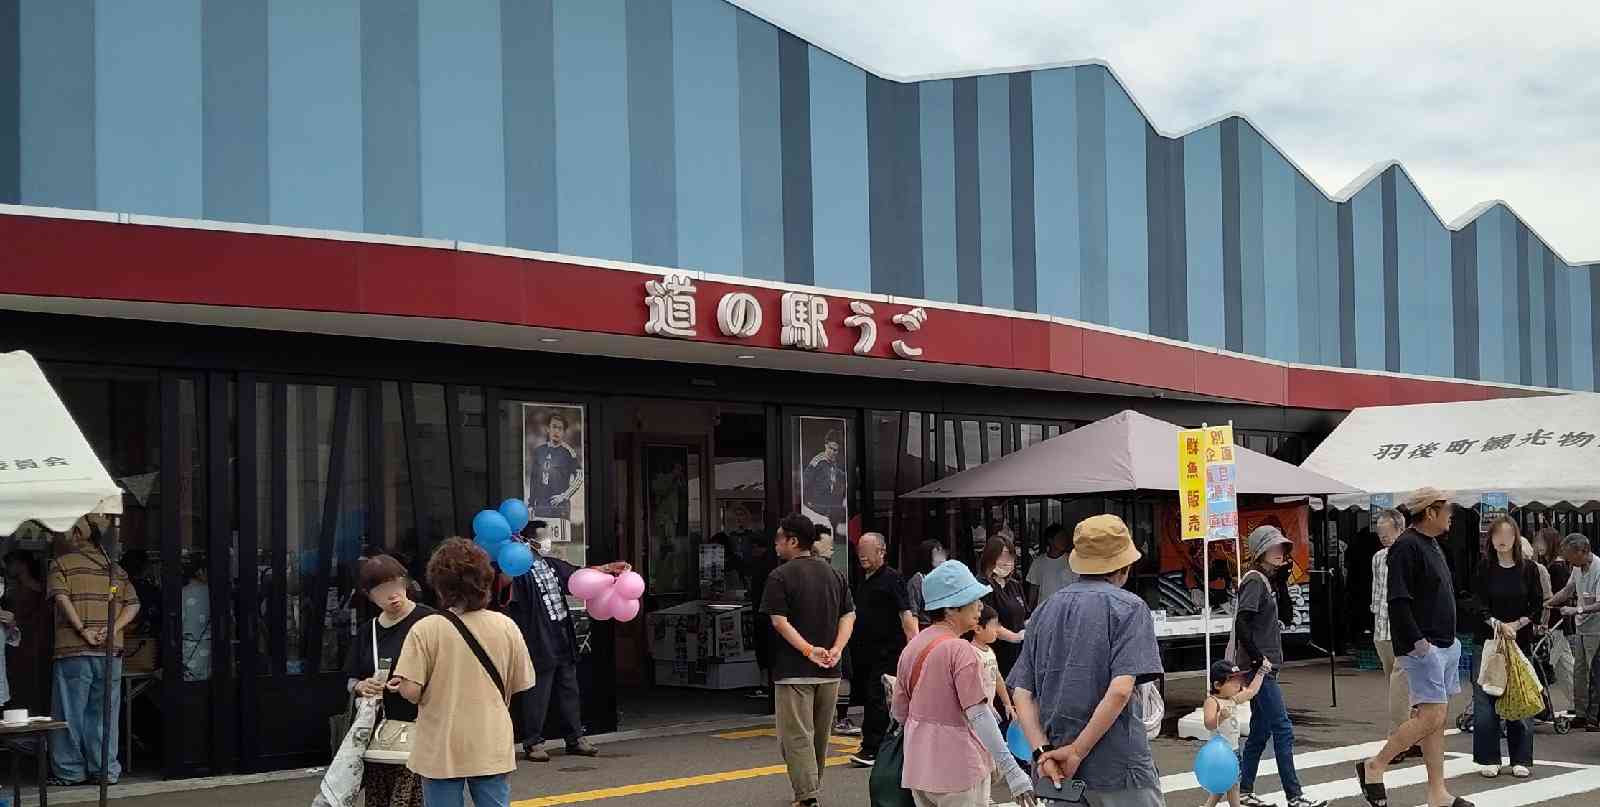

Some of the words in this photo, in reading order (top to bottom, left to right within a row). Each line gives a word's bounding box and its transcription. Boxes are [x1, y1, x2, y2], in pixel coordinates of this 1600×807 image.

[645, 272, 928, 356] 道の駅うご
[1186, 437, 1200, 532] 鮮魚販売
[1372, 429, 1600, 460] 羽後町観光物
